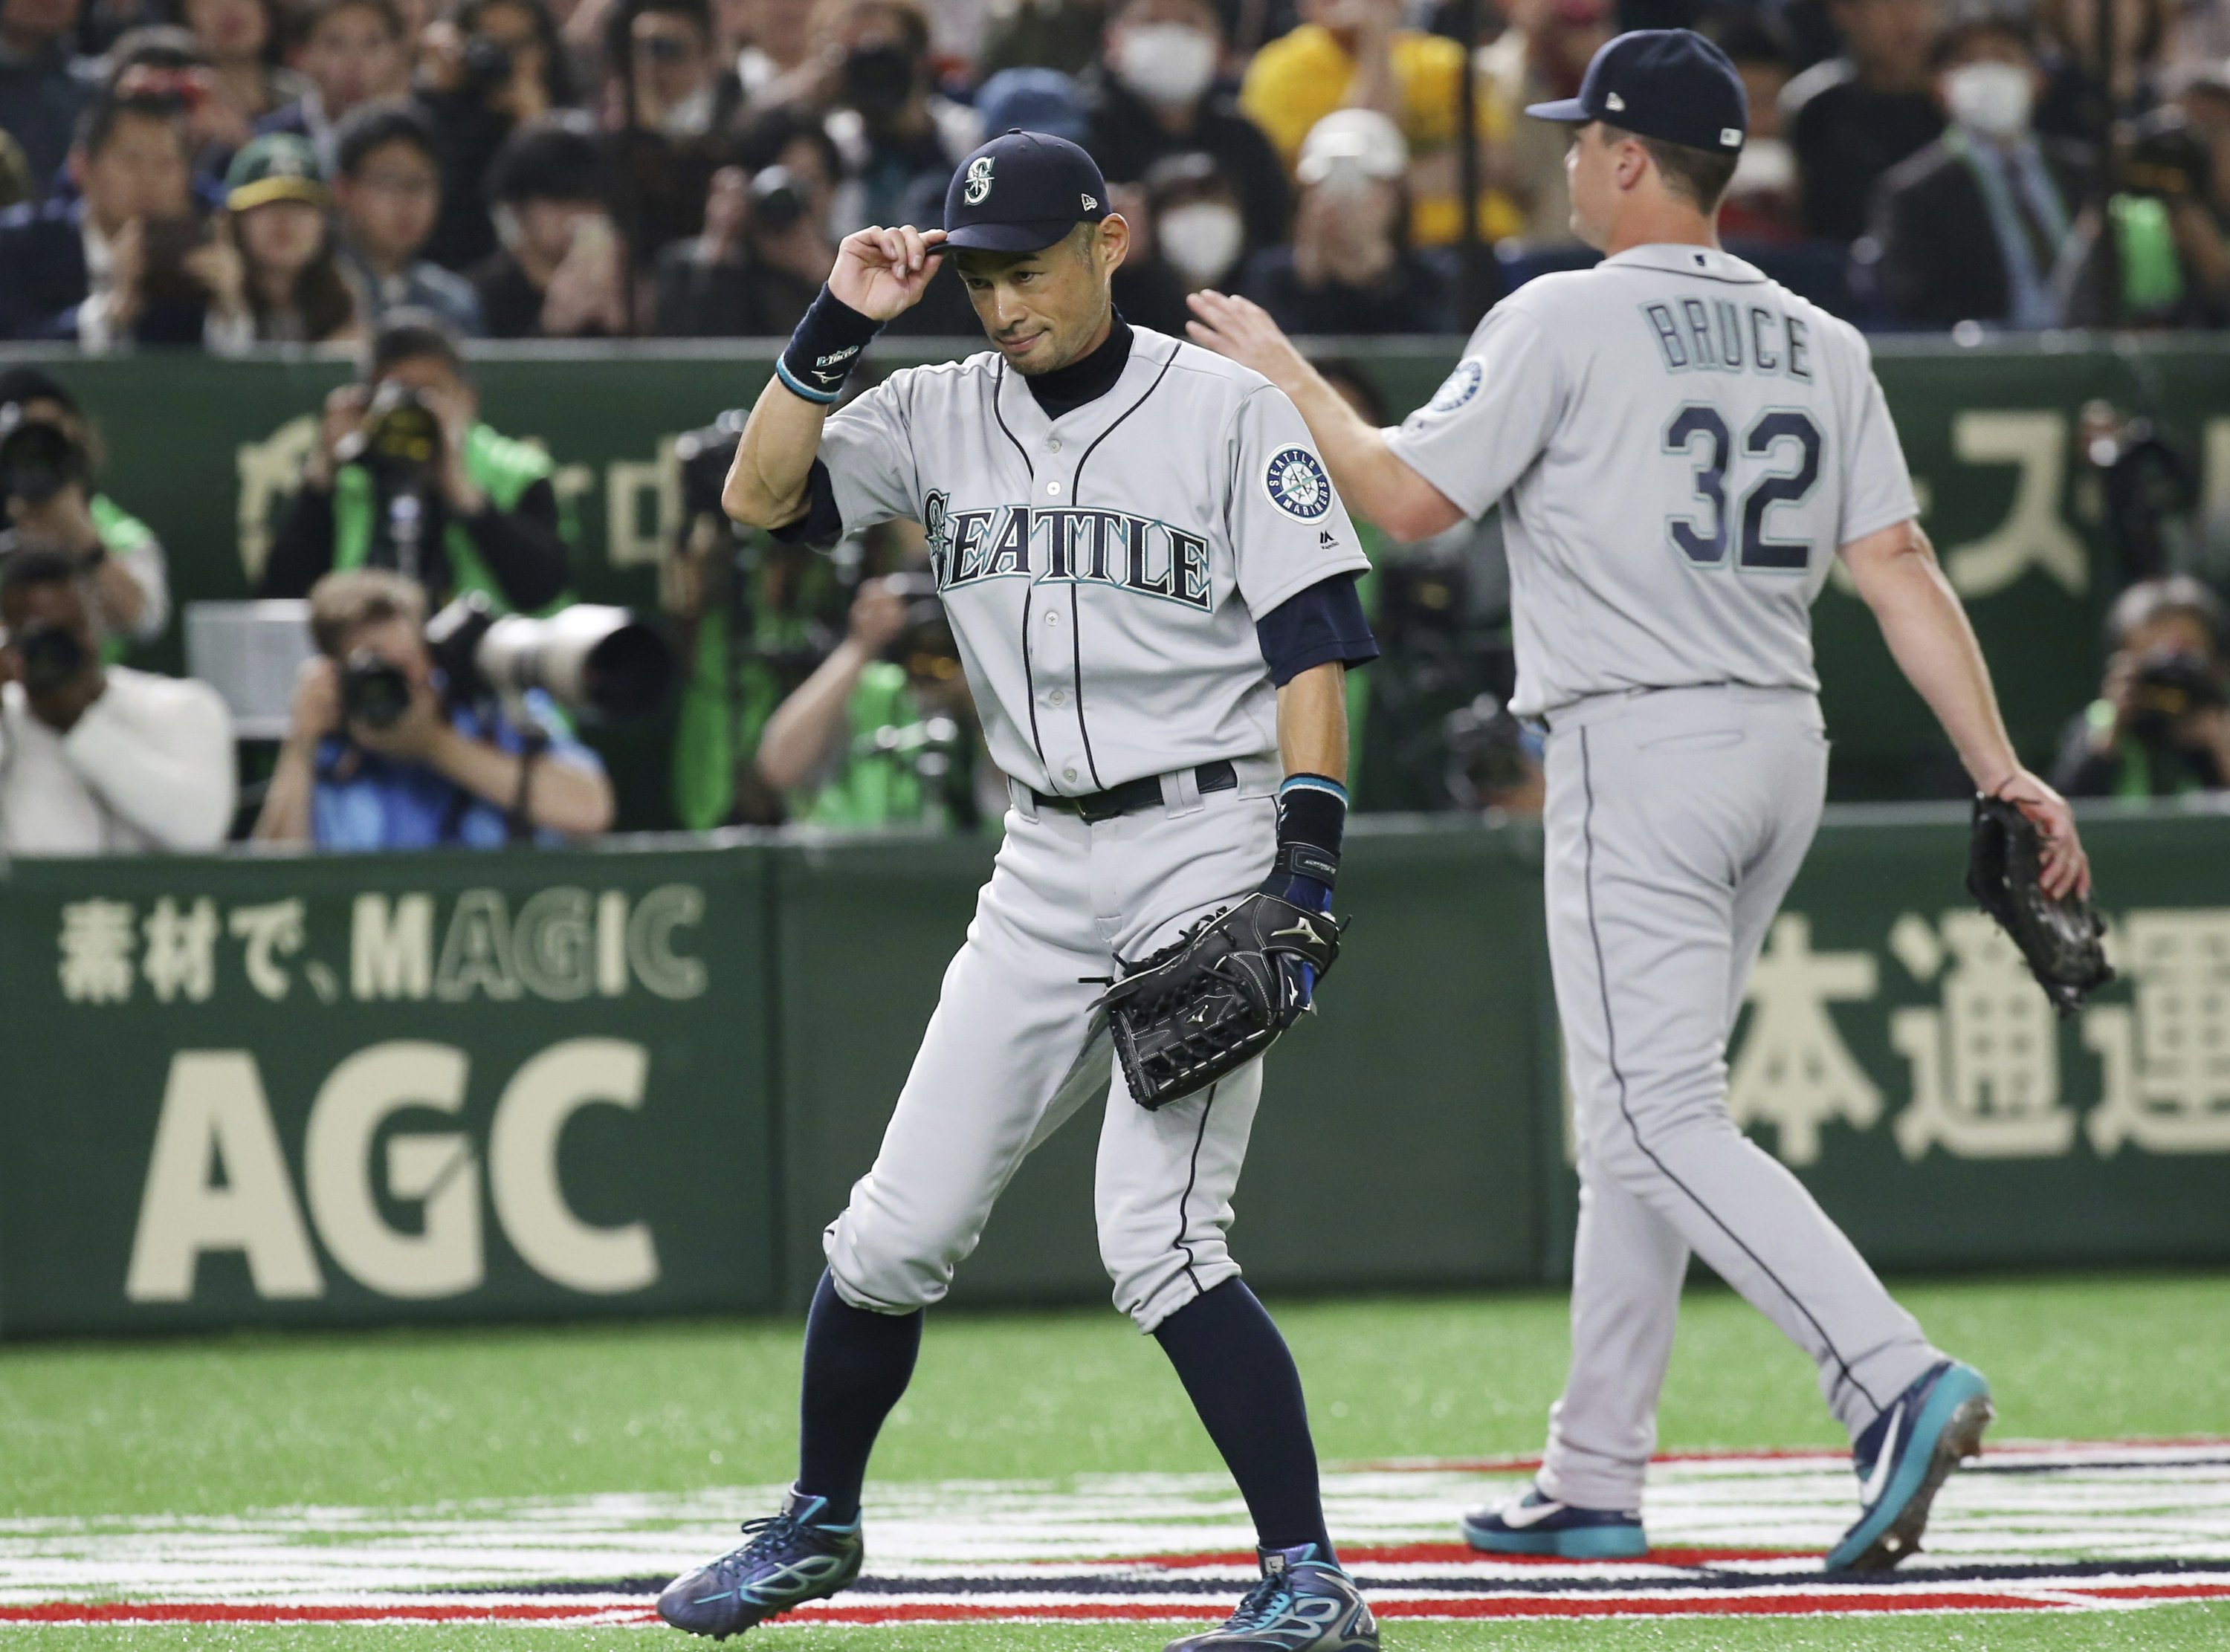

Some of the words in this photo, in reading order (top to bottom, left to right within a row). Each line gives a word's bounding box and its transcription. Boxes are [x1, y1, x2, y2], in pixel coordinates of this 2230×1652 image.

[1638, 296, 1814, 386] BRUCE
[1269, 450, 1316, 487] SEATTLE
[1282, 482, 1329, 516] MARINERS
[1660, 399, 1829, 576] 32
[922, 487, 1215, 614] SEATTLE
[1560, 908, 2230, 1167] 本通運
[125, 1036, 662, 1303] AGC
